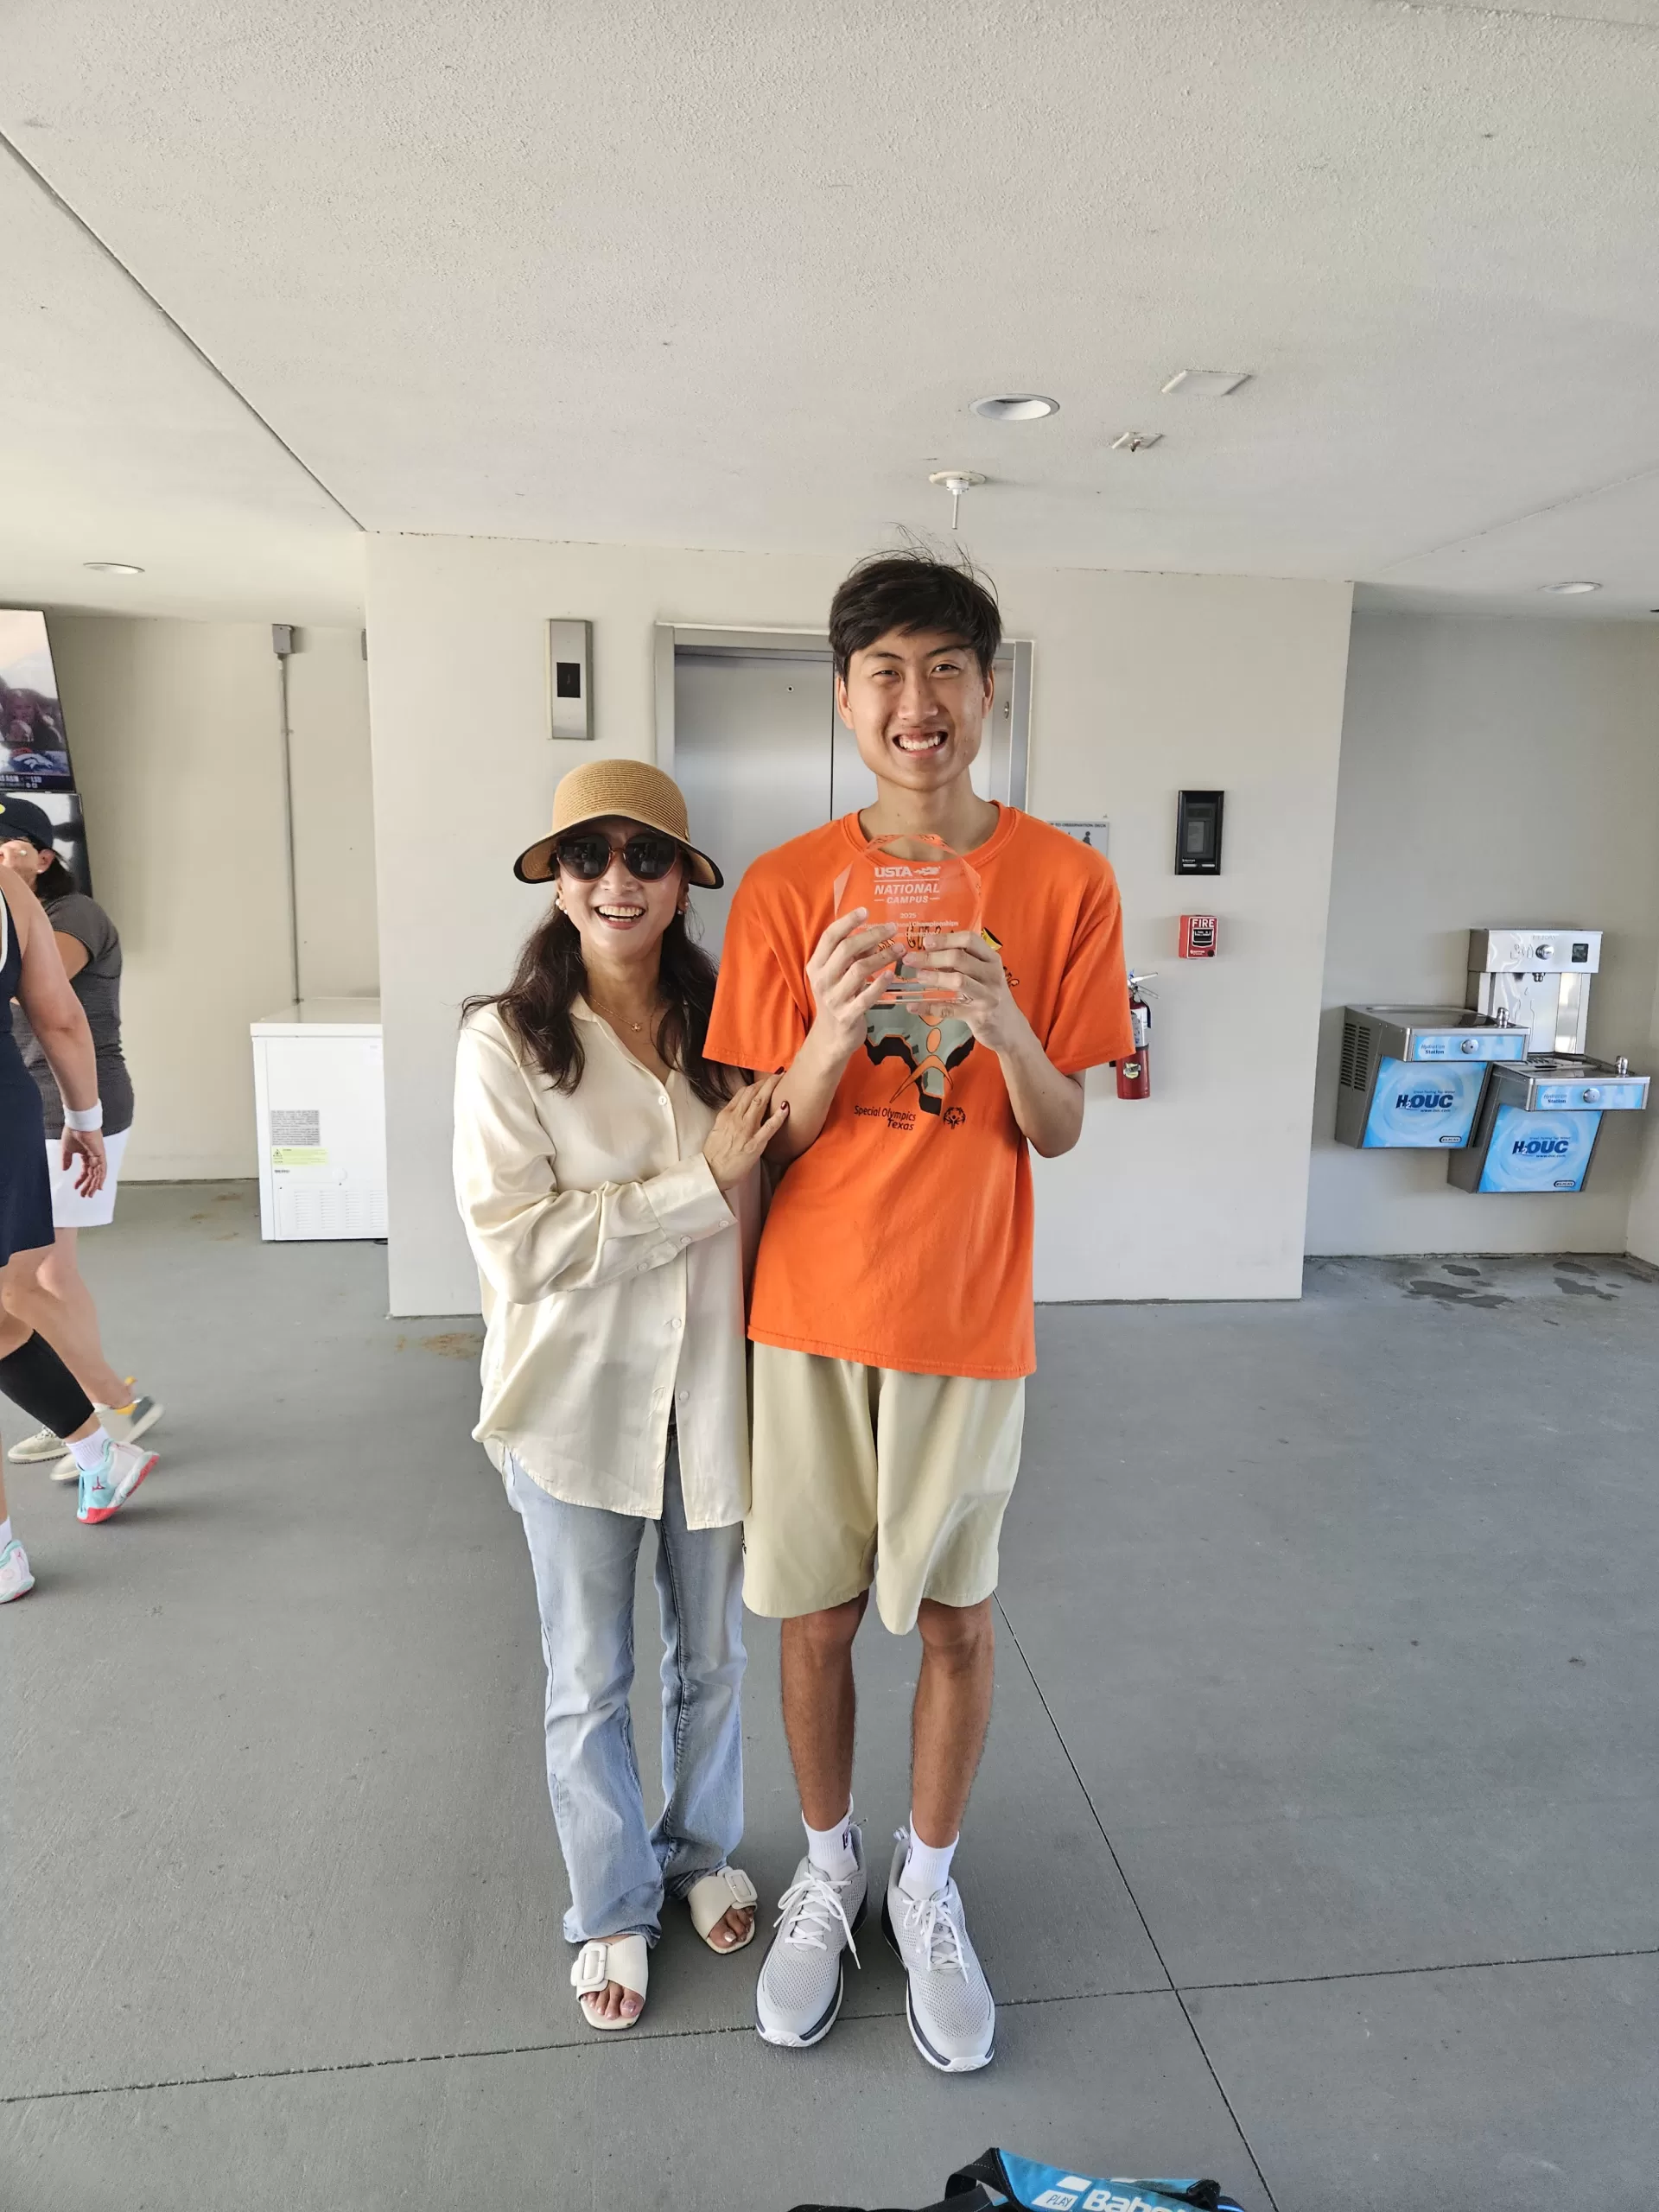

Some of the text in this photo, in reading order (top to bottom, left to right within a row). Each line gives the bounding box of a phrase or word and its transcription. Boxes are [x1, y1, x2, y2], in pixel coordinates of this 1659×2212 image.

[874, 866, 913, 877] USTA
[874, 883, 940, 895] NATIONAL
[1192, 918, 1215, 928] FIRE
[854, 1105, 916, 1122] Special Olympics
[887, 1117, 914, 1131] Texas
[1046, 2194, 1073, 2208] PLAY
